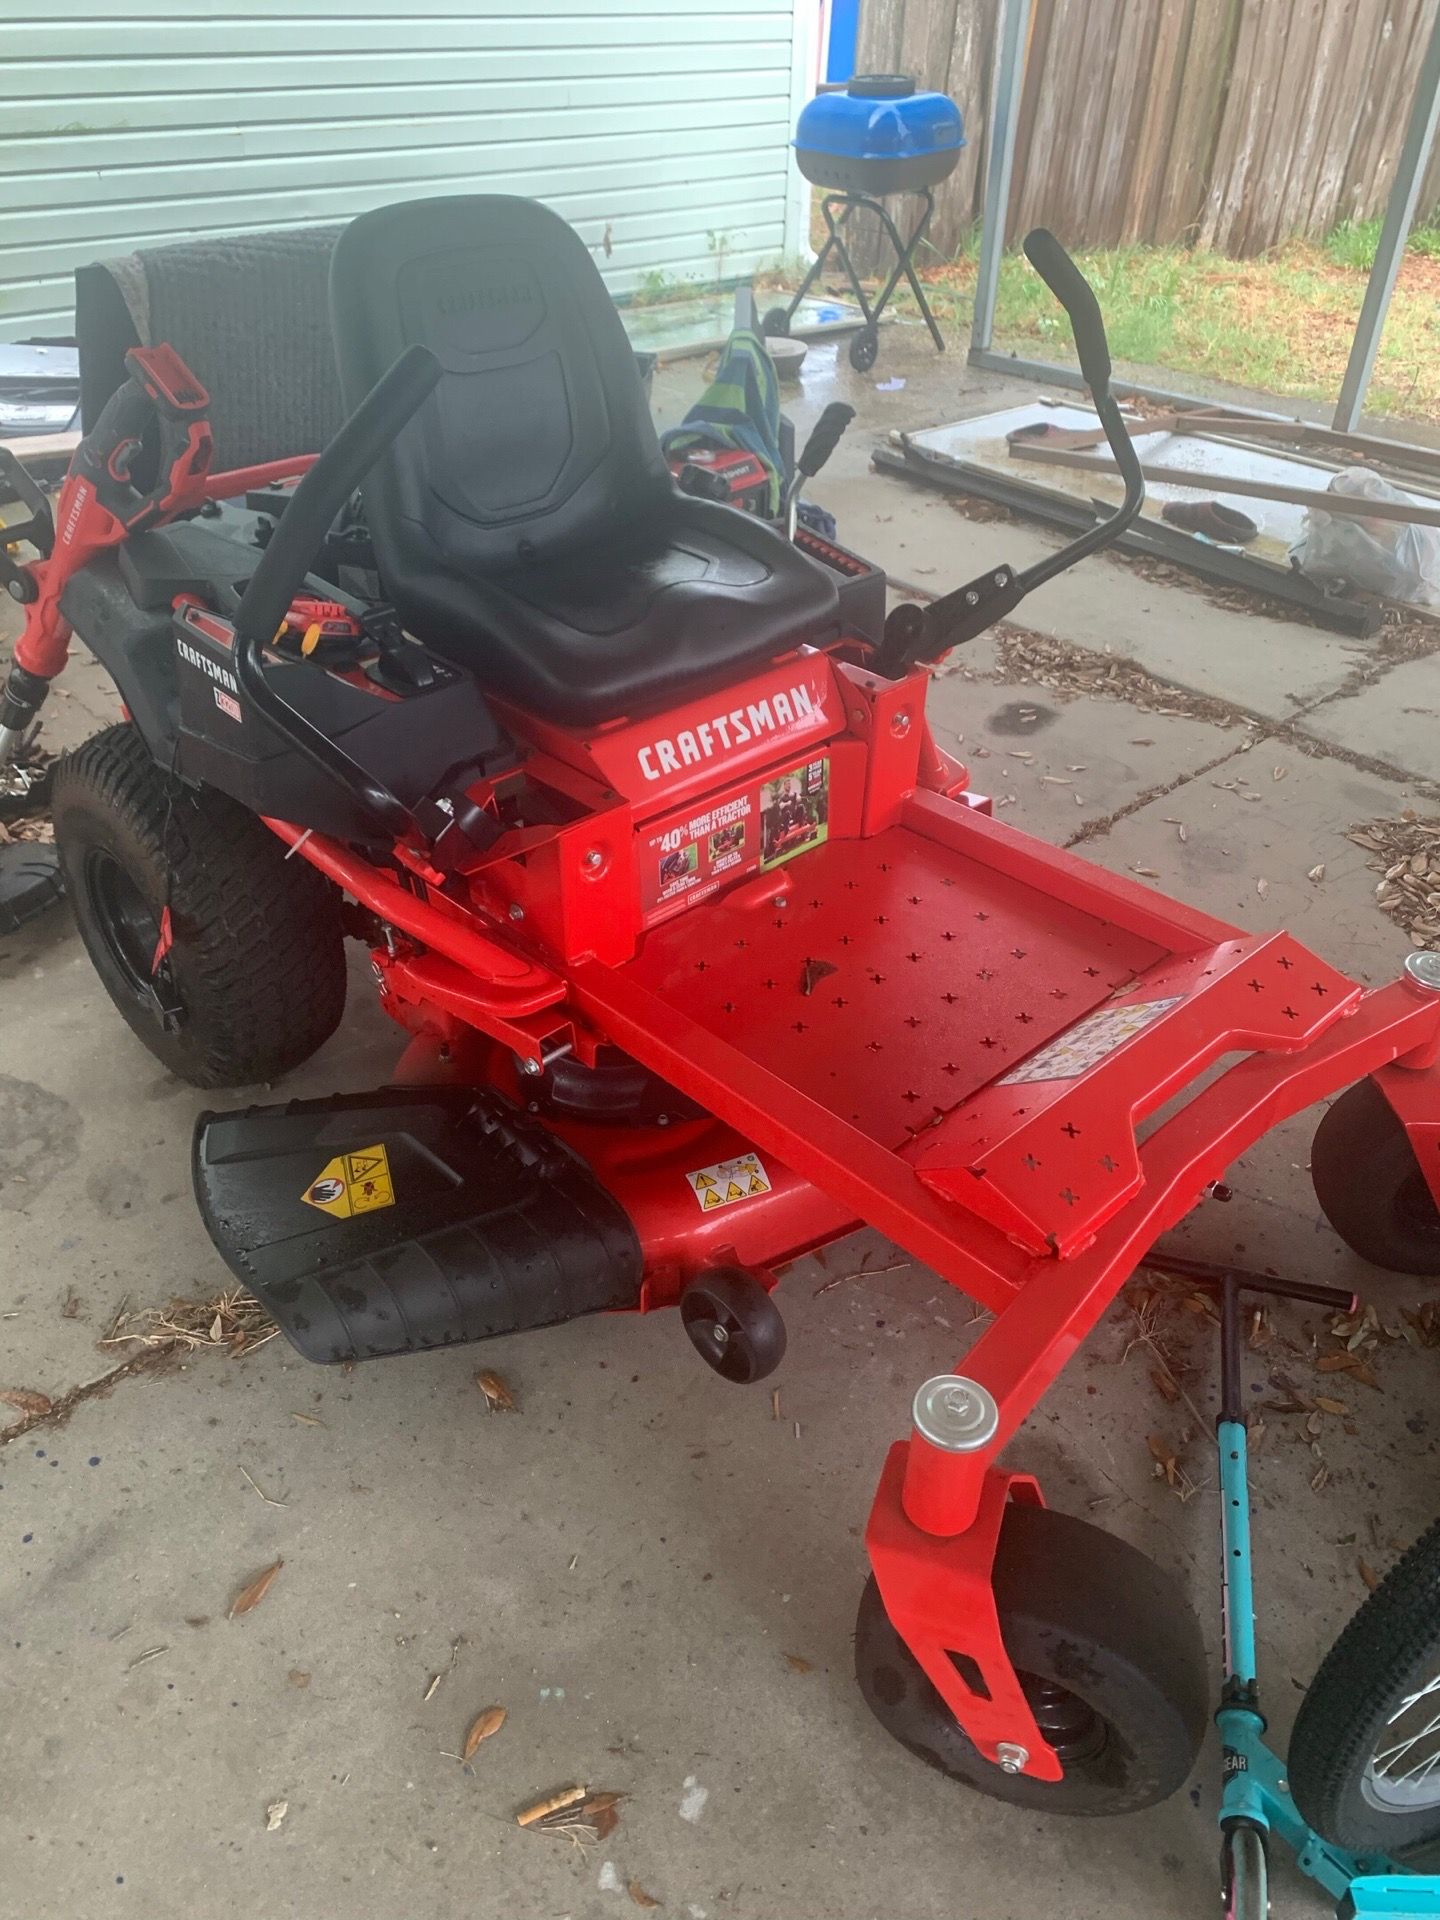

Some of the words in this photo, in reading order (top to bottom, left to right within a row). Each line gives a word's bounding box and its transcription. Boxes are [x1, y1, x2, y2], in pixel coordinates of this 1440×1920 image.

[62, 486, 88, 545] CRAFTSMAN
[176, 638, 239, 694] CRAFTSMAN
[637, 684, 813, 780] CRAFTSMAN
[689, 812, 711, 832] MORE
[711, 795, 748, 820] EFFICIENT
[690, 822, 711, 840] THAN
[711, 818, 717, 830] A
[717, 804, 751, 827] TRACTOR
[661, 824, 689, 852] 40%
